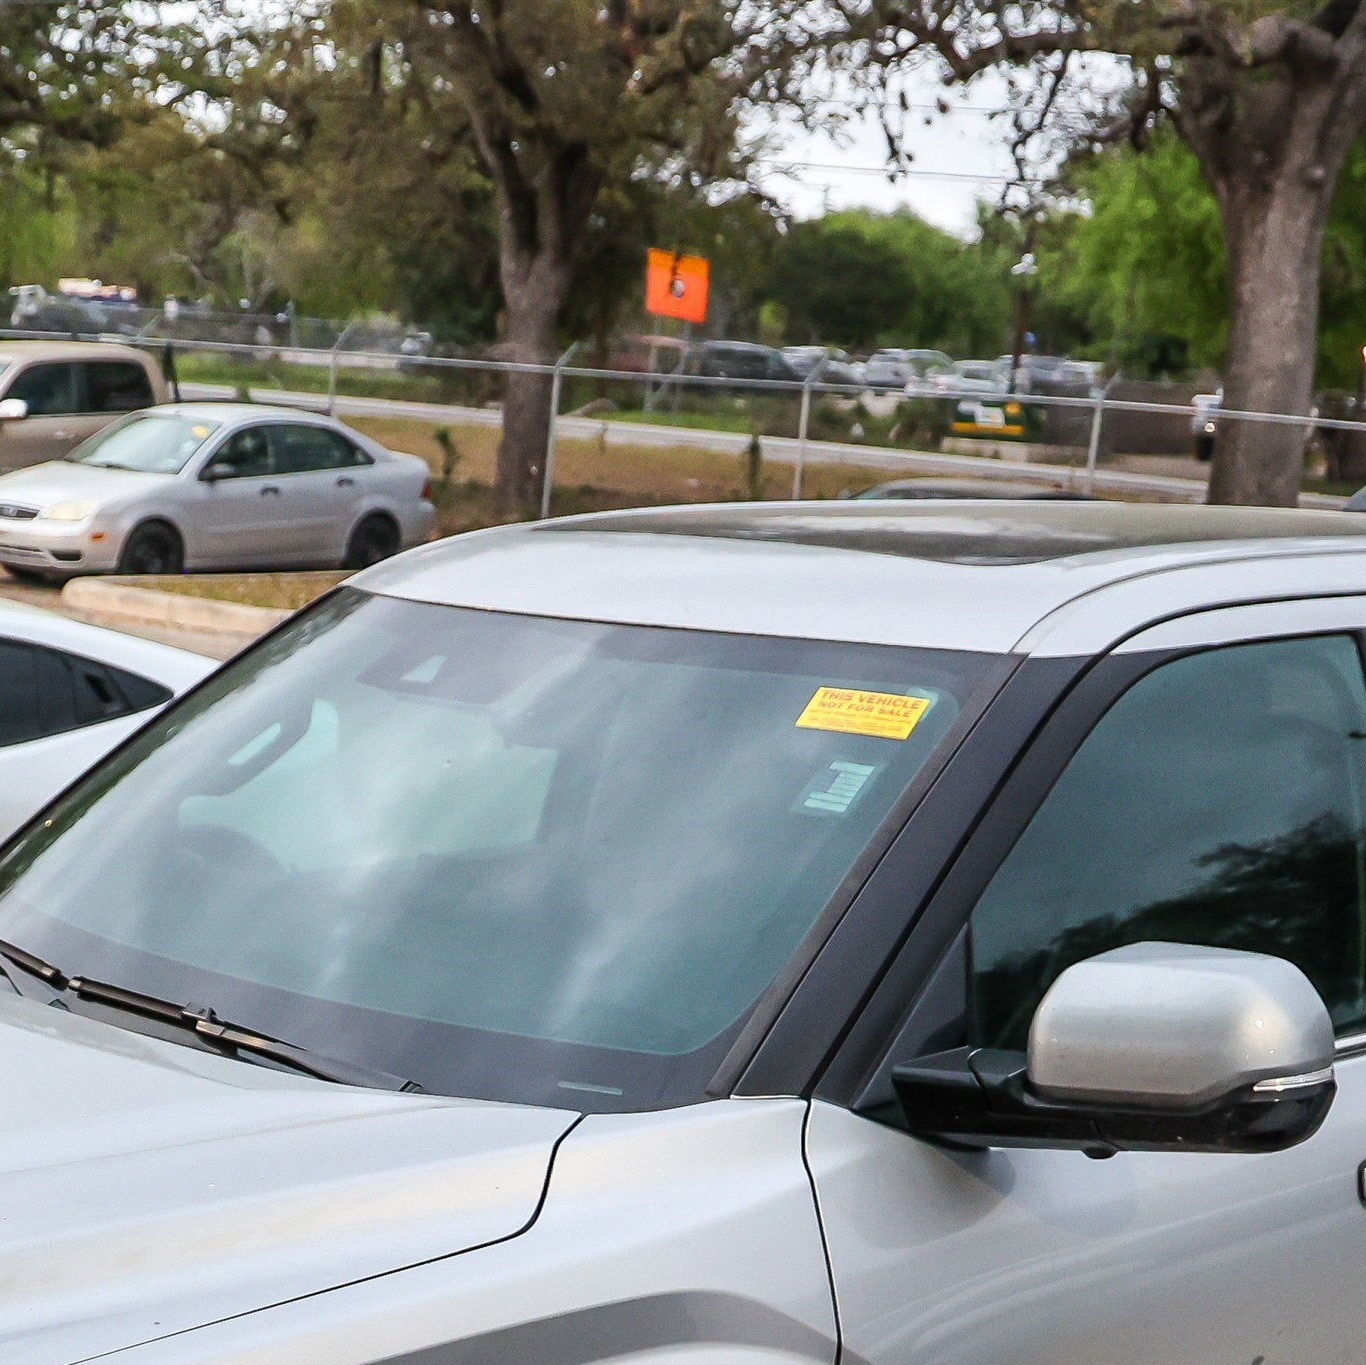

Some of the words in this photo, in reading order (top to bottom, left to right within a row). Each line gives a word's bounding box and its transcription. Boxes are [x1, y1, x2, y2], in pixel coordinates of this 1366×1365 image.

[822, 690, 853, 701] THIS
[858, 692, 922, 709] VEHICLE
[847, 703, 874, 713] FOR
[877, 708, 913, 718] SALE
